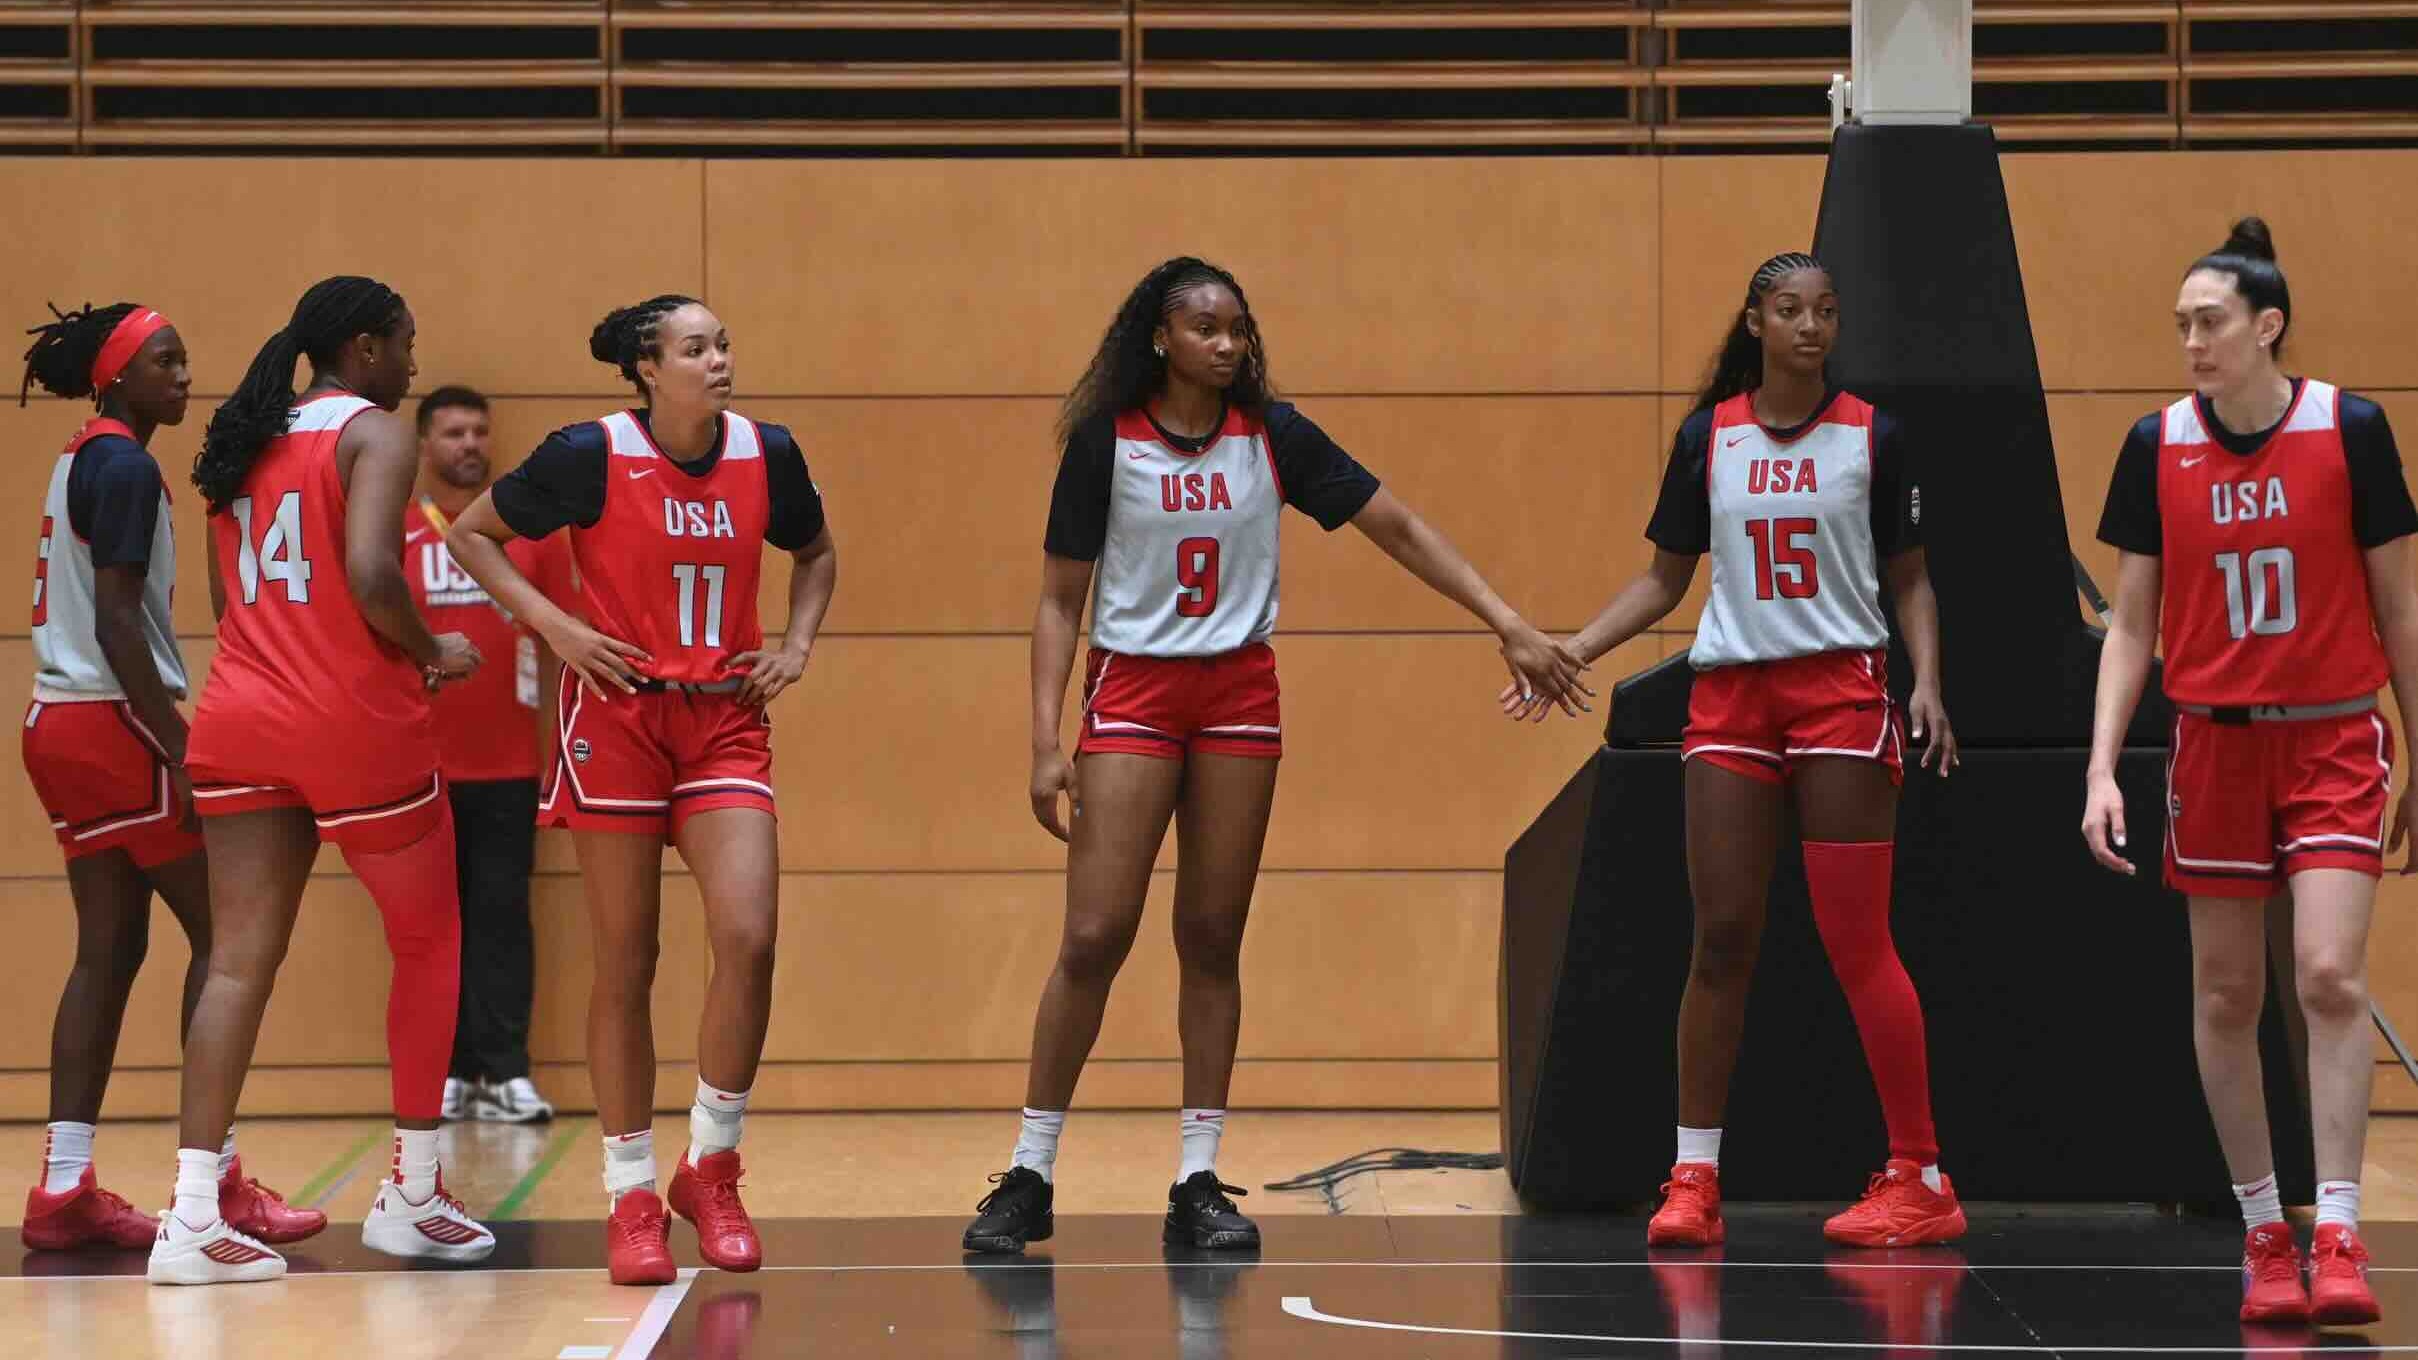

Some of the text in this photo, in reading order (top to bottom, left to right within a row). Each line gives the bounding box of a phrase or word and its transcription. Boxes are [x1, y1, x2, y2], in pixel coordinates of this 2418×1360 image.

[1161, 472, 1232, 512] USA
[1748, 457, 1818, 494] USA
[2211, 477, 2288, 524] USA
[231, 490, 313, 605] 14
[663, 497, 735, 538] USA
[421, 542, 481, 591] US
[1176, 537, 1220, 617] 9
[1745, 518, 1819, 600] 15
[672, 563, 727, 647] 11
[2215, 548, 2297, 640] 10
